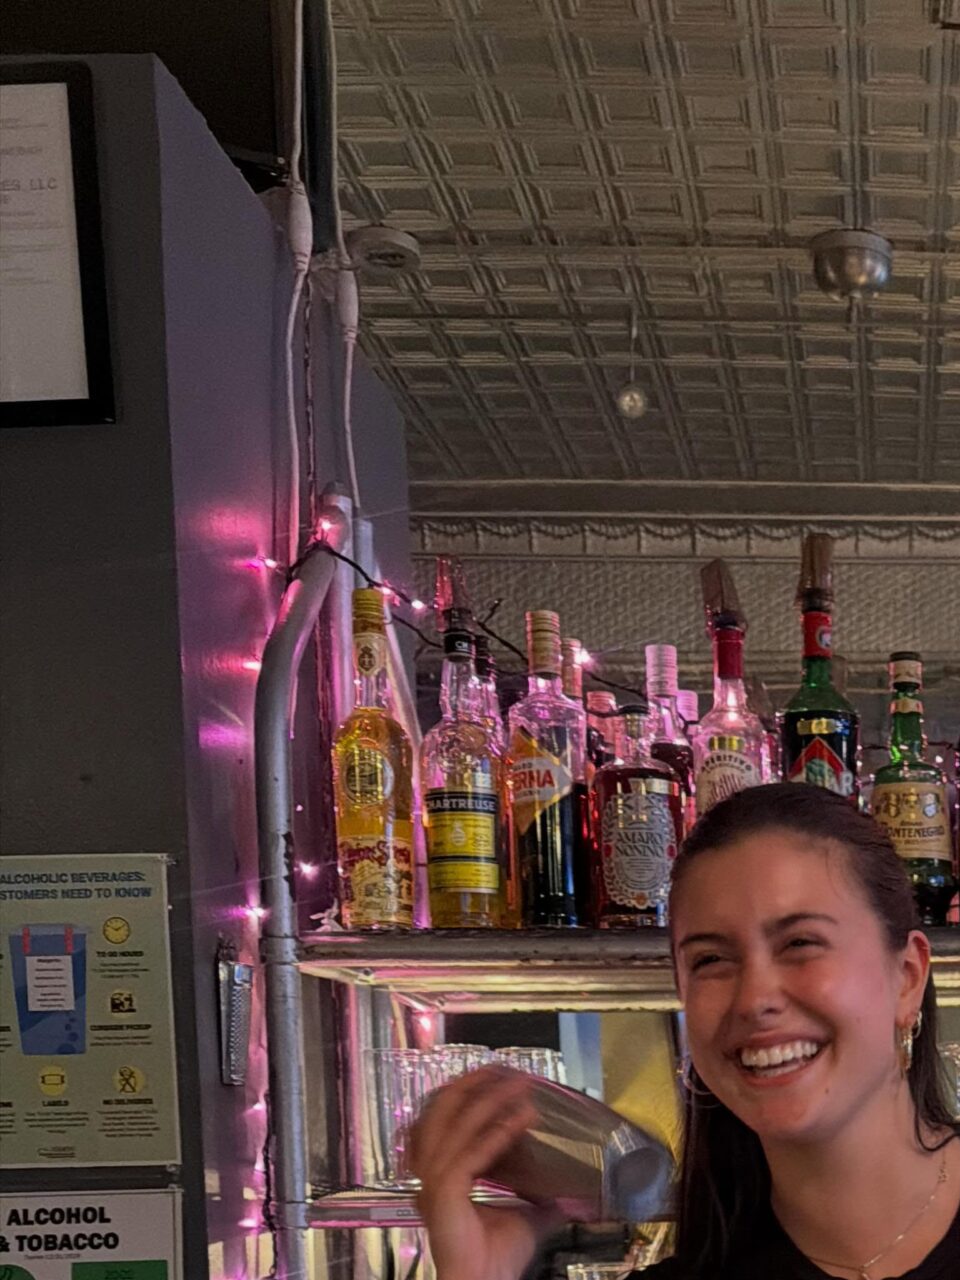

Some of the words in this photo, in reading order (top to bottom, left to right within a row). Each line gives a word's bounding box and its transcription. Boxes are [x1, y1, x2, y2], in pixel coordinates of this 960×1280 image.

[701, 754, 752, 773] APERITIVO
[426, 798, 497, 811] CHARTREUSE
[616, 831, 663, 844] AMARO
[884, 825, 945, 839] ONTENEGRO
[615, 844, 664, 858] NONINO
[0, 872, 69, 885] ALCOHOLIC
[61, 888, 93, 899] NEED
[95, 887, 112, 899] TO
[115, 886, 152, 898] KNOW
[6, 1206, 111, 1226] ALCOHOL
[0, 1236, 10, 1252] &
[15, 1231, 120, 1252] TOBACCO
